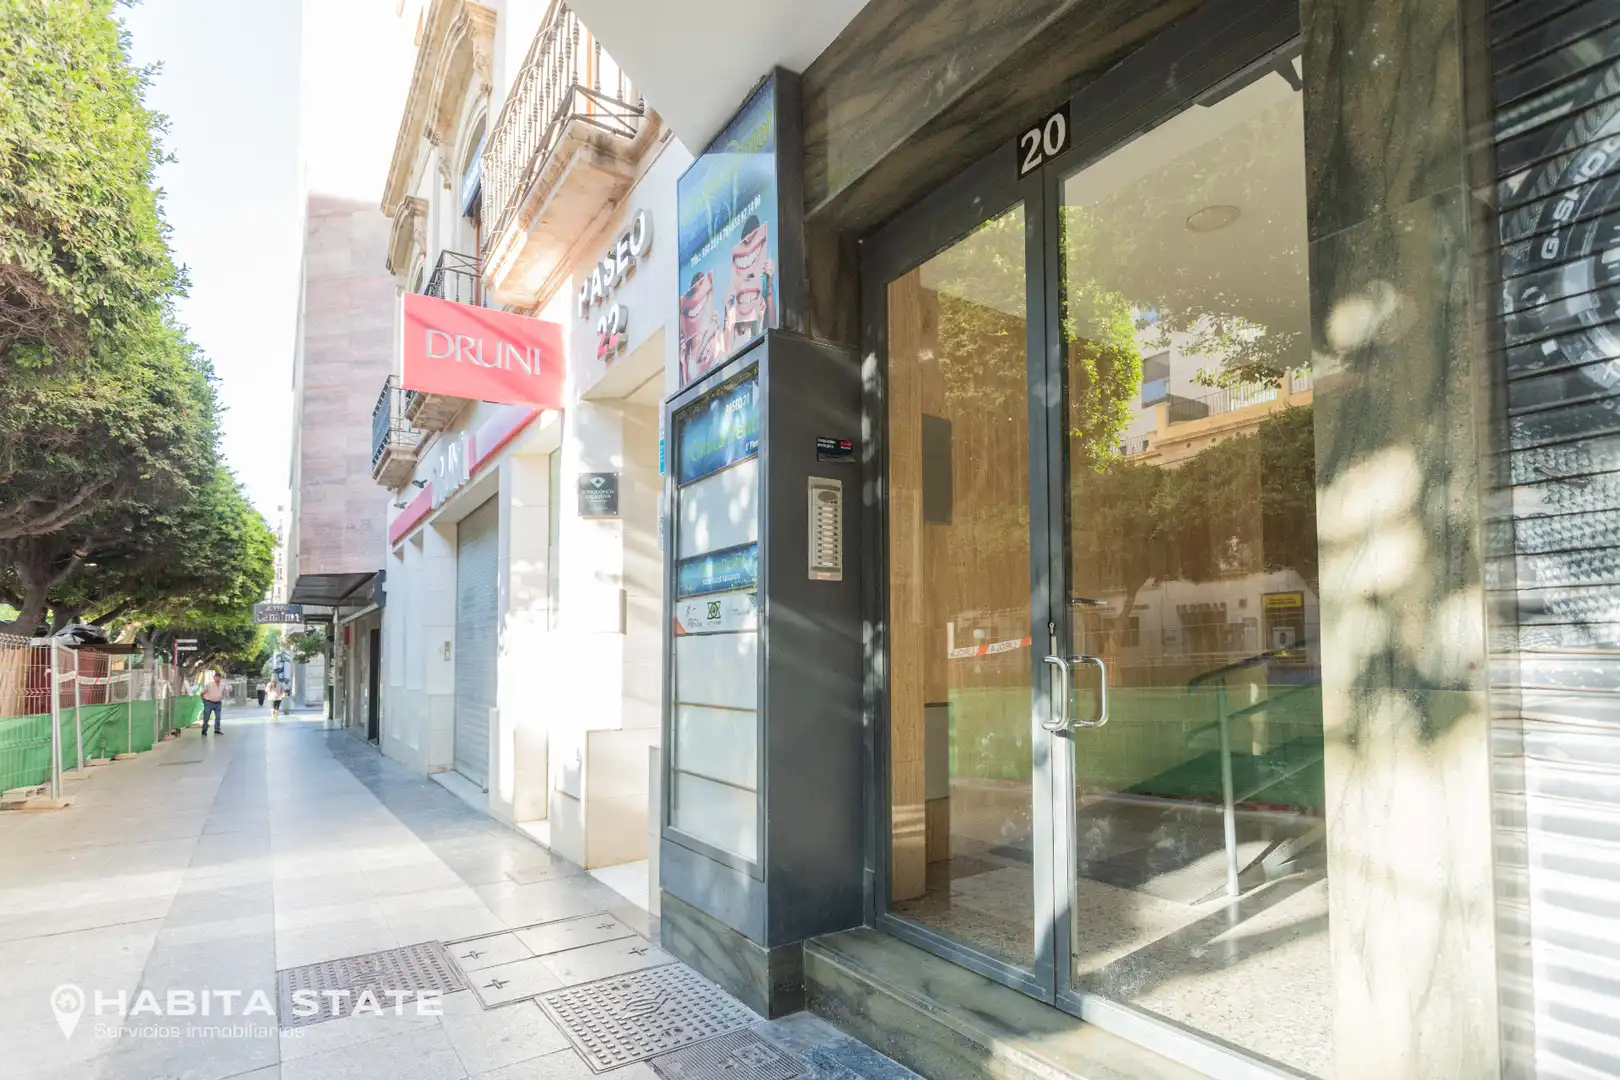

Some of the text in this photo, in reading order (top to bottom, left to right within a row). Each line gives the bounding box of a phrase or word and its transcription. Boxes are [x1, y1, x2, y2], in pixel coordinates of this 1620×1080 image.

[1020, 112, 1067, 175] 20
[578, 209, 652, 318] PASEO
[424, 328, 541, 376] DRUNI
[597, 303, 627, 361] 22
